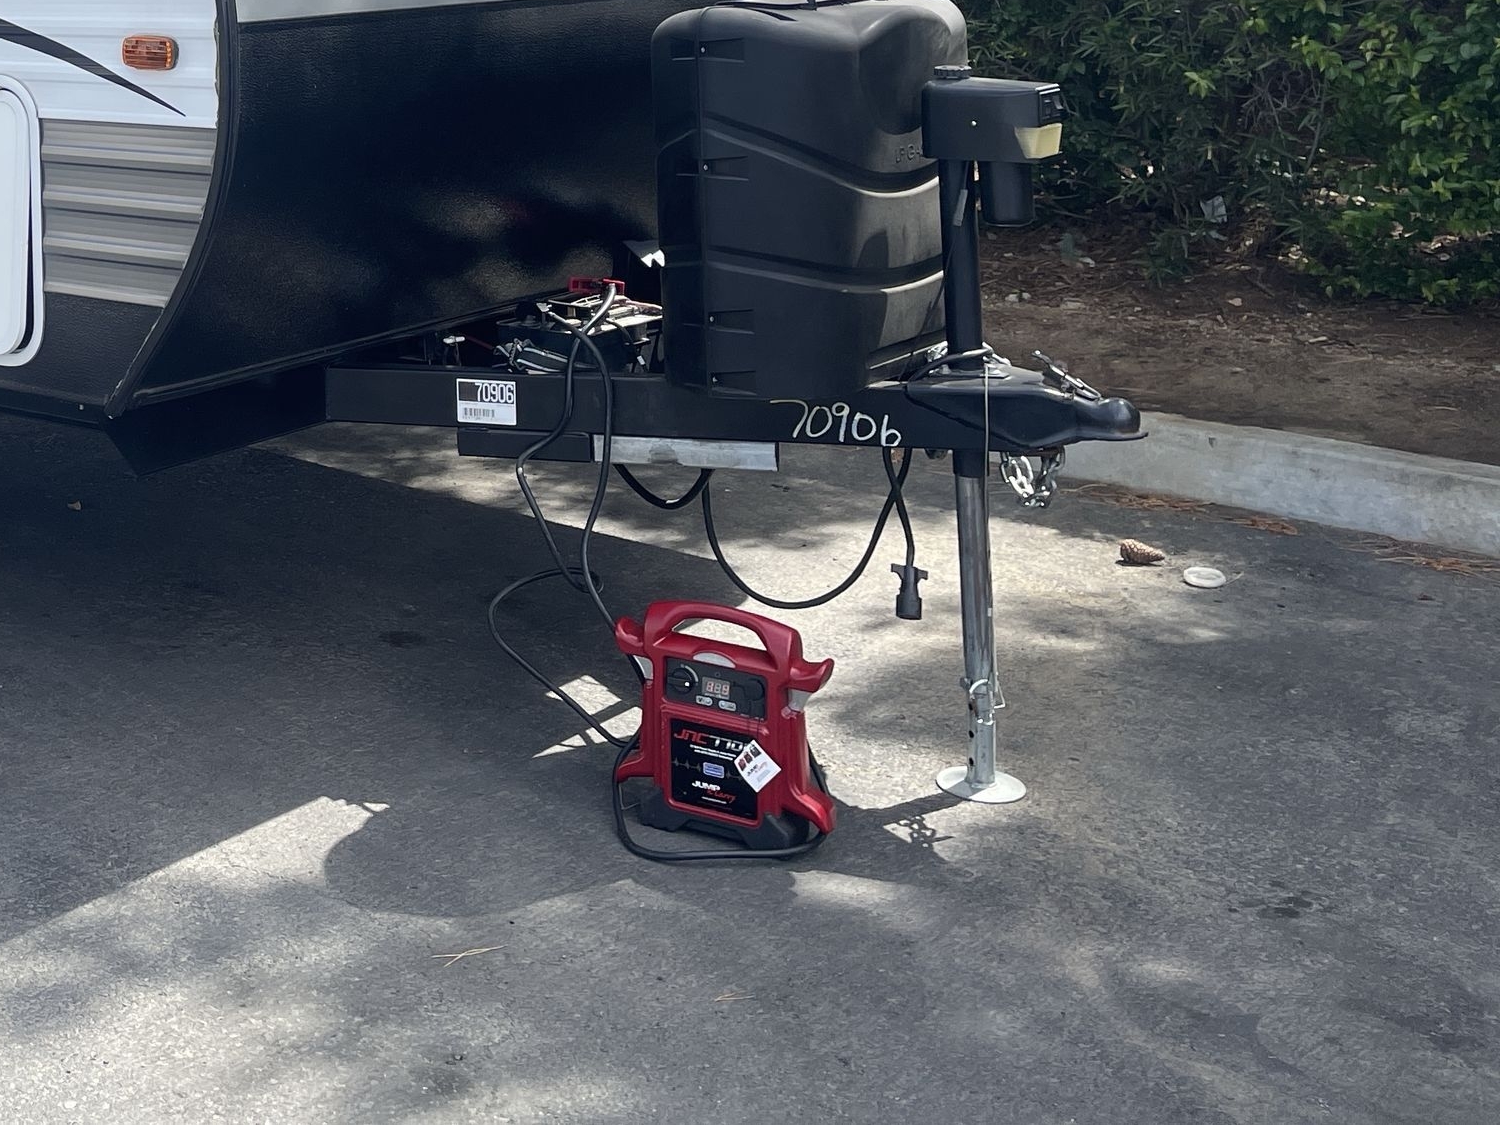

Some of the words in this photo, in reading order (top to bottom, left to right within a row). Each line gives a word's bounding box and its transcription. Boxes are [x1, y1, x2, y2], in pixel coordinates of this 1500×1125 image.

[474, 382, 514, 403] 70906
[770, 399, 901, 447] 70906
[691, 780, 721, 791] JUMP
